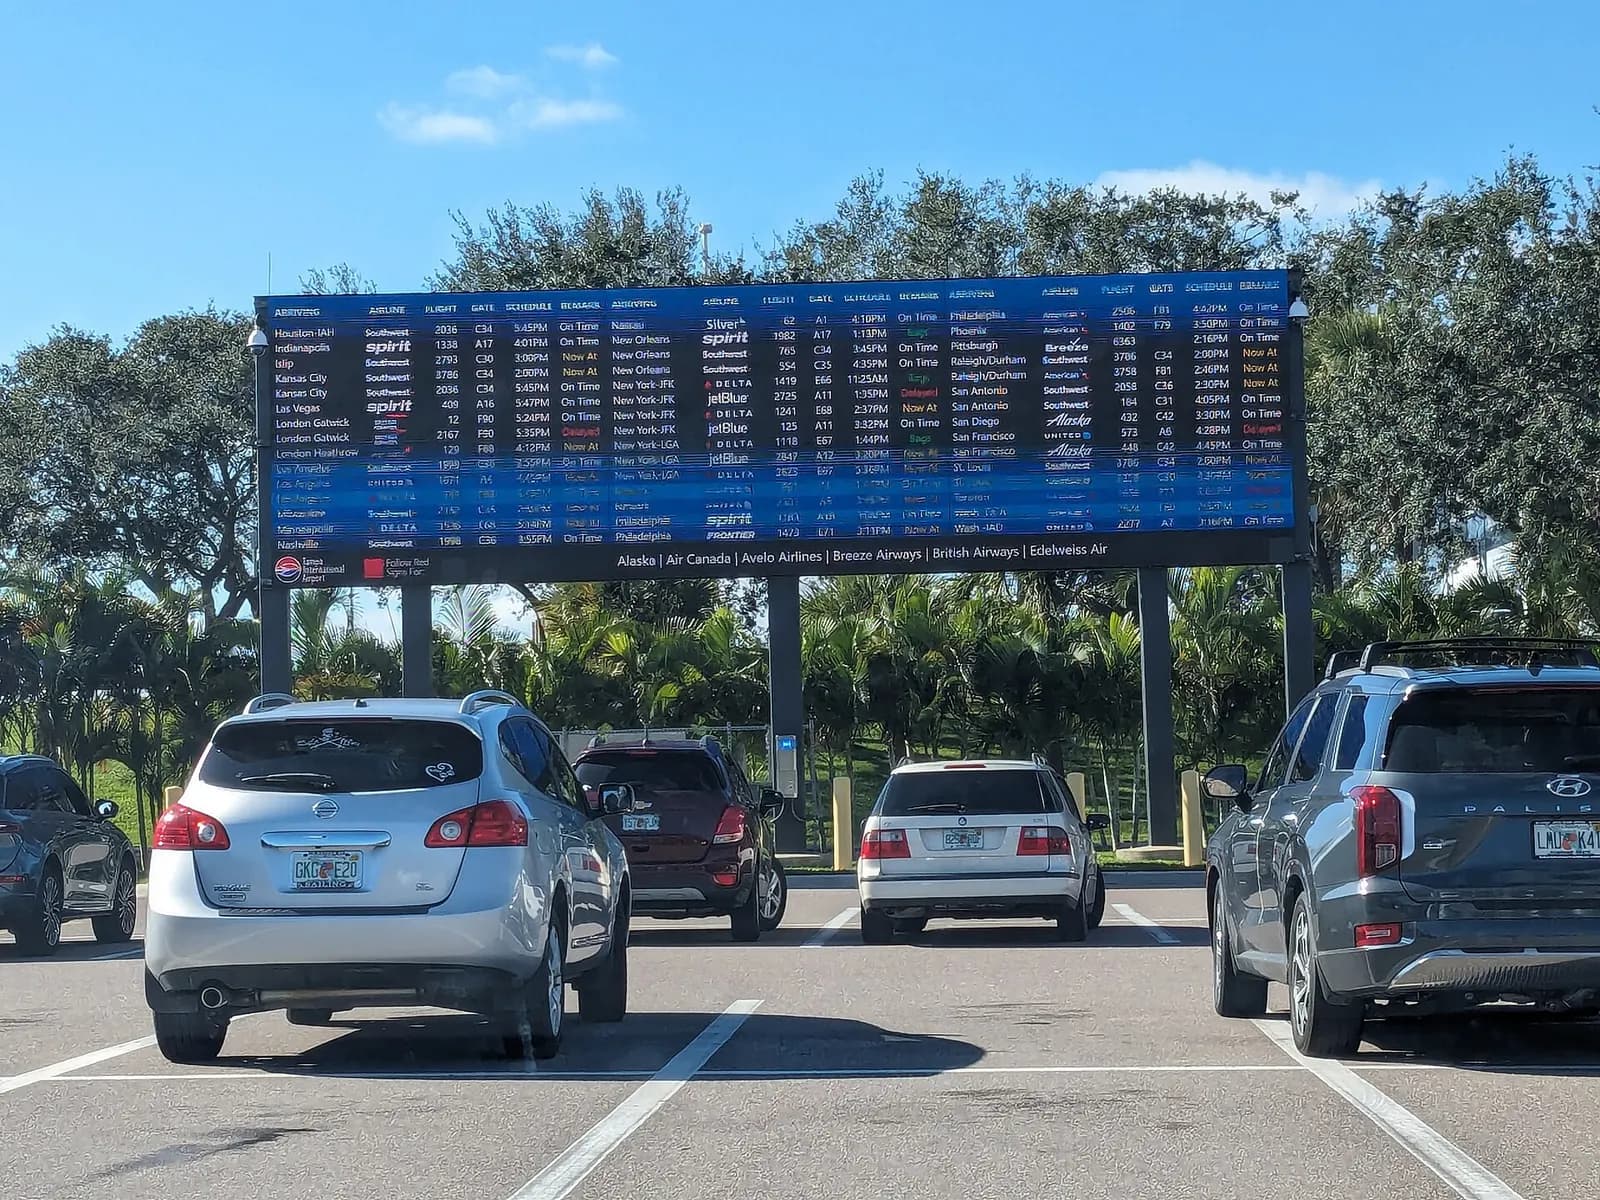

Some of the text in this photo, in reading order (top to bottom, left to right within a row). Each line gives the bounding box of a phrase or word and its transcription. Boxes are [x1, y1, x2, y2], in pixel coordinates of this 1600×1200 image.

[435, 326, 457, 334] 2036
[706, 314, 912, 330] Silver 62 On
[1240, 318, 1279, 327] On Time
[275, 338, 574, 354] Indianapolis spirit A17 On
[702, 331, 831, 346] spirit 1982 A17
[951, 333, 1279, 352] Pittsburgh 2:16PM On Time
[436, 355, 458, 364] 2793
[563, 353, 584, 361] Now
[612, 343, 938, 360] New Orleans On Time
[1242, 349, 1264, 357] Now
[1267, 348, 1277, 356] At
[613, 358, 938, 375] New Southwest 4:35PM On Time
[1114, 364, 1278, 377] 3758 Now At
[276, 368, 584, 384] Kansas City Southwest Now
[613, 374, 888, 390] New York-JFK DELTA 1419 E66 11:25AM
[276, 383, 600, 399] Kansas City 2036 C34 5:45PM On Time
[952, 379, 1278, 395] San Antonio Southwest 2058 C36 2:30PM Now At
[276, 398, 600, 414] Las Vegas spirit A16 5:47PM On Time
[613, 391, 832, 406] New York-JFK jetBlue 2725 A11
[952, 393, 1280, 411] San Antonio Southwest C31 4:05PM On Time
[614, 403, 937, 420] New York-JFK DELTA 1241 E68 2:37PM Now At
[952, 409, 1281, 427] San Diego Alaska 432 C42 3:30PM On Time
[276, 412, 601, 428] London Gatwick 12 F90 On Time
[614, 418, 940, 437] New York-JFK jetBlue 125 A11 On Time
[276, 428, 550, 443] London Gatwick 2167 5:35PM
[637, 437, 832, 449] York-LGA DELTA 1118 E67
[953, 432, 969, 442] San
[972, 432, 1015, 440] Francisco
[1121, 428, 1138, 437] 573
[277, 450, 311, 459] London
[1047, 439, 1282, 456] Alaska C42 On Time
[617, 543, 1108, 567] Alaska Air Canada Avelo Airlines Breeze Airways British Airways Edelweiss Air
